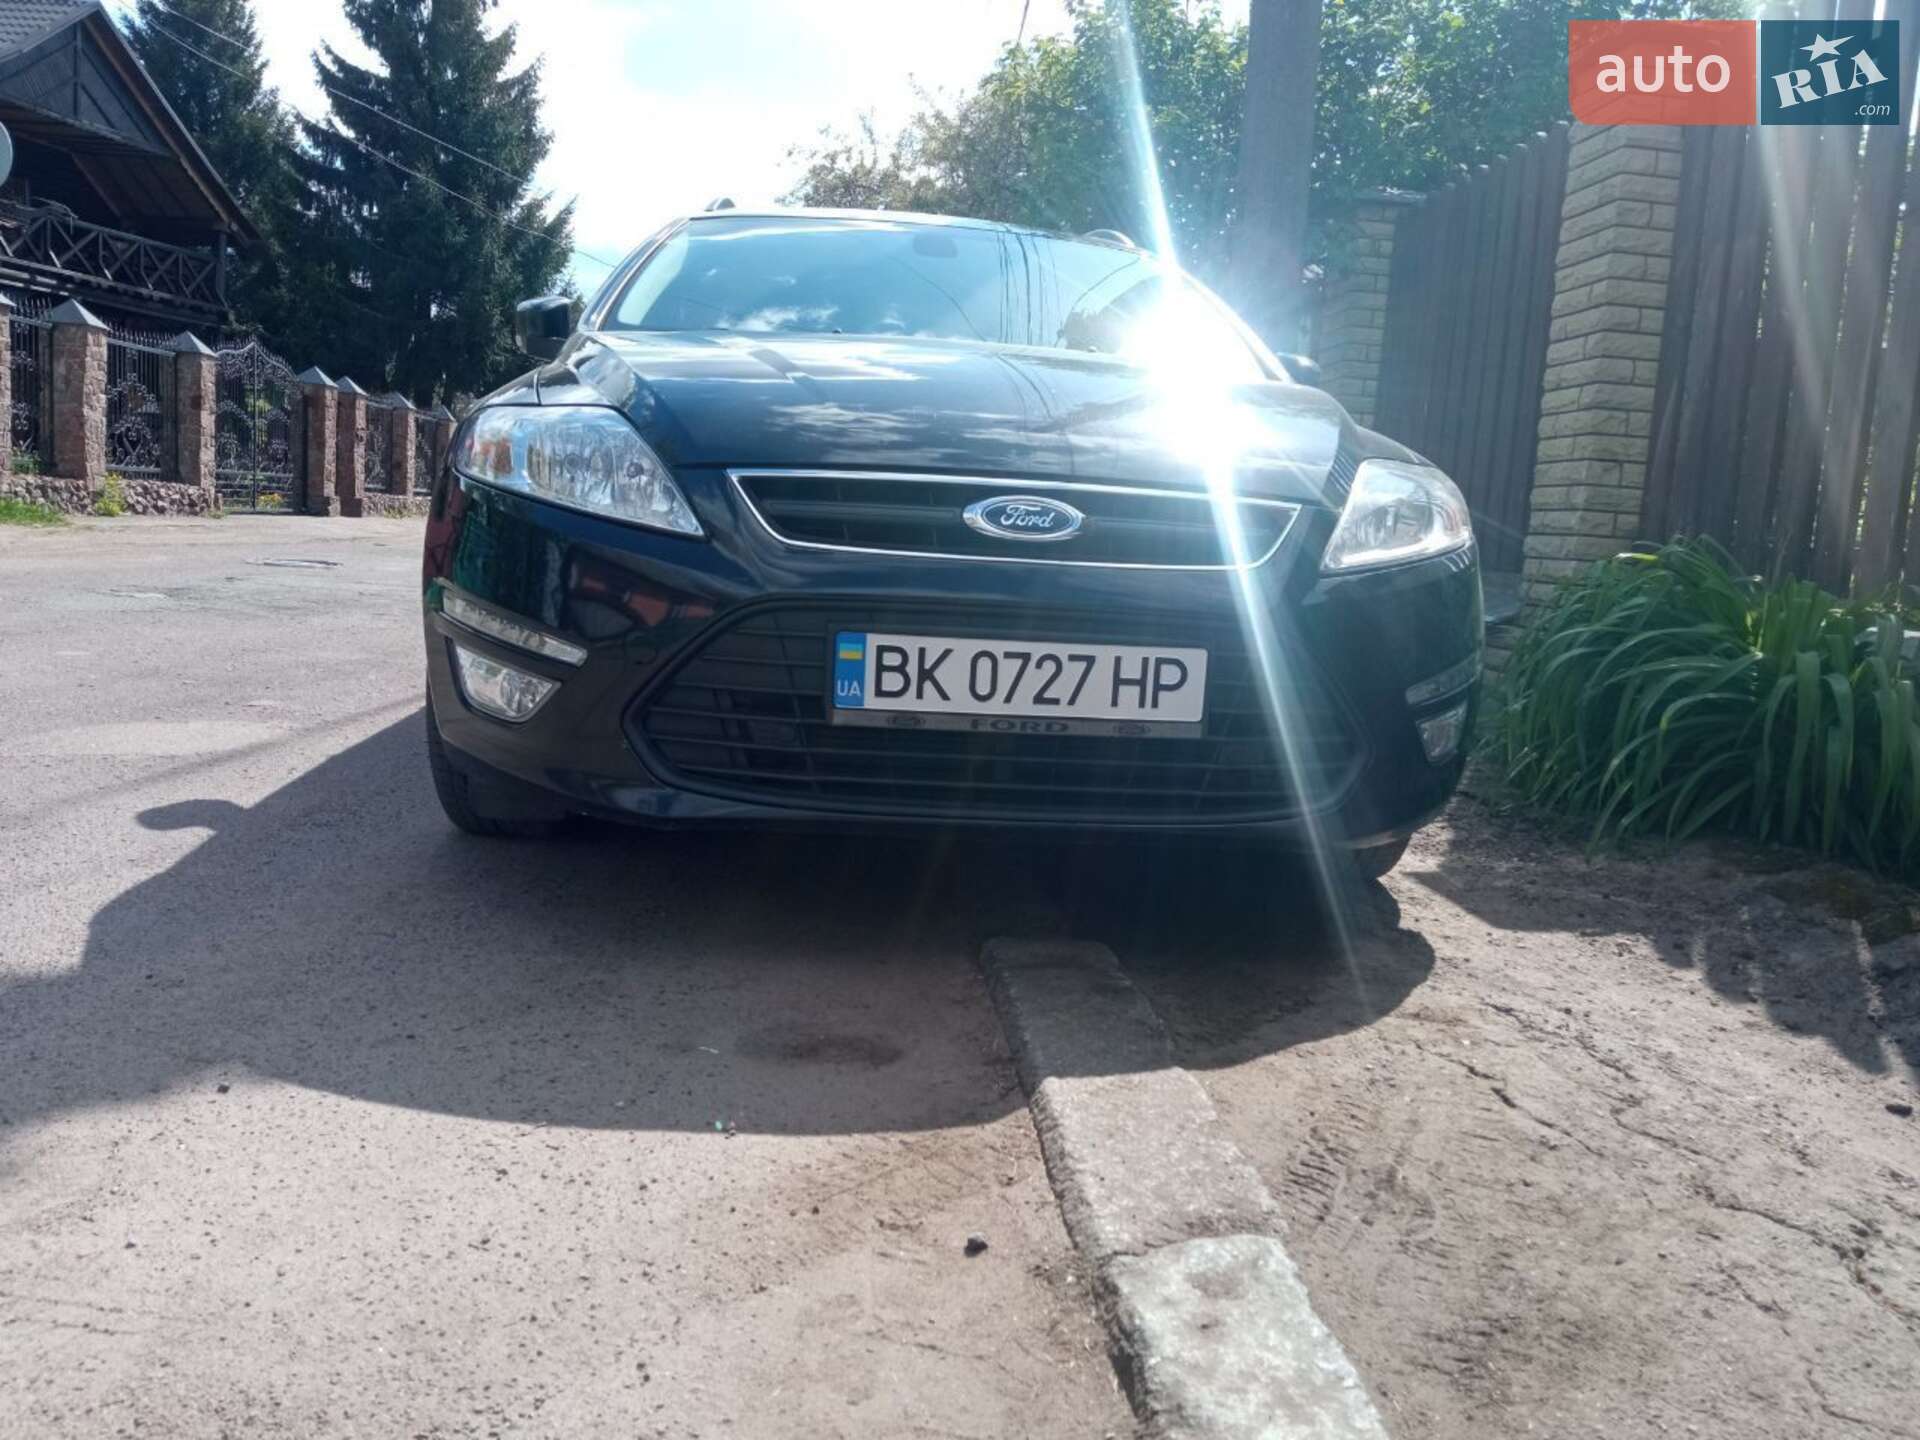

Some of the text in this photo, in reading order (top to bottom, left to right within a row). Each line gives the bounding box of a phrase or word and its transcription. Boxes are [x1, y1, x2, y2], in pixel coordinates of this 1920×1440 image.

[1000, 504, 1055, 527] Ford
[874, 645, 1188, 708] BK 0727 HP
[836, 680, 861, 697] UA
[970, 719, 1068, 734] FORD
